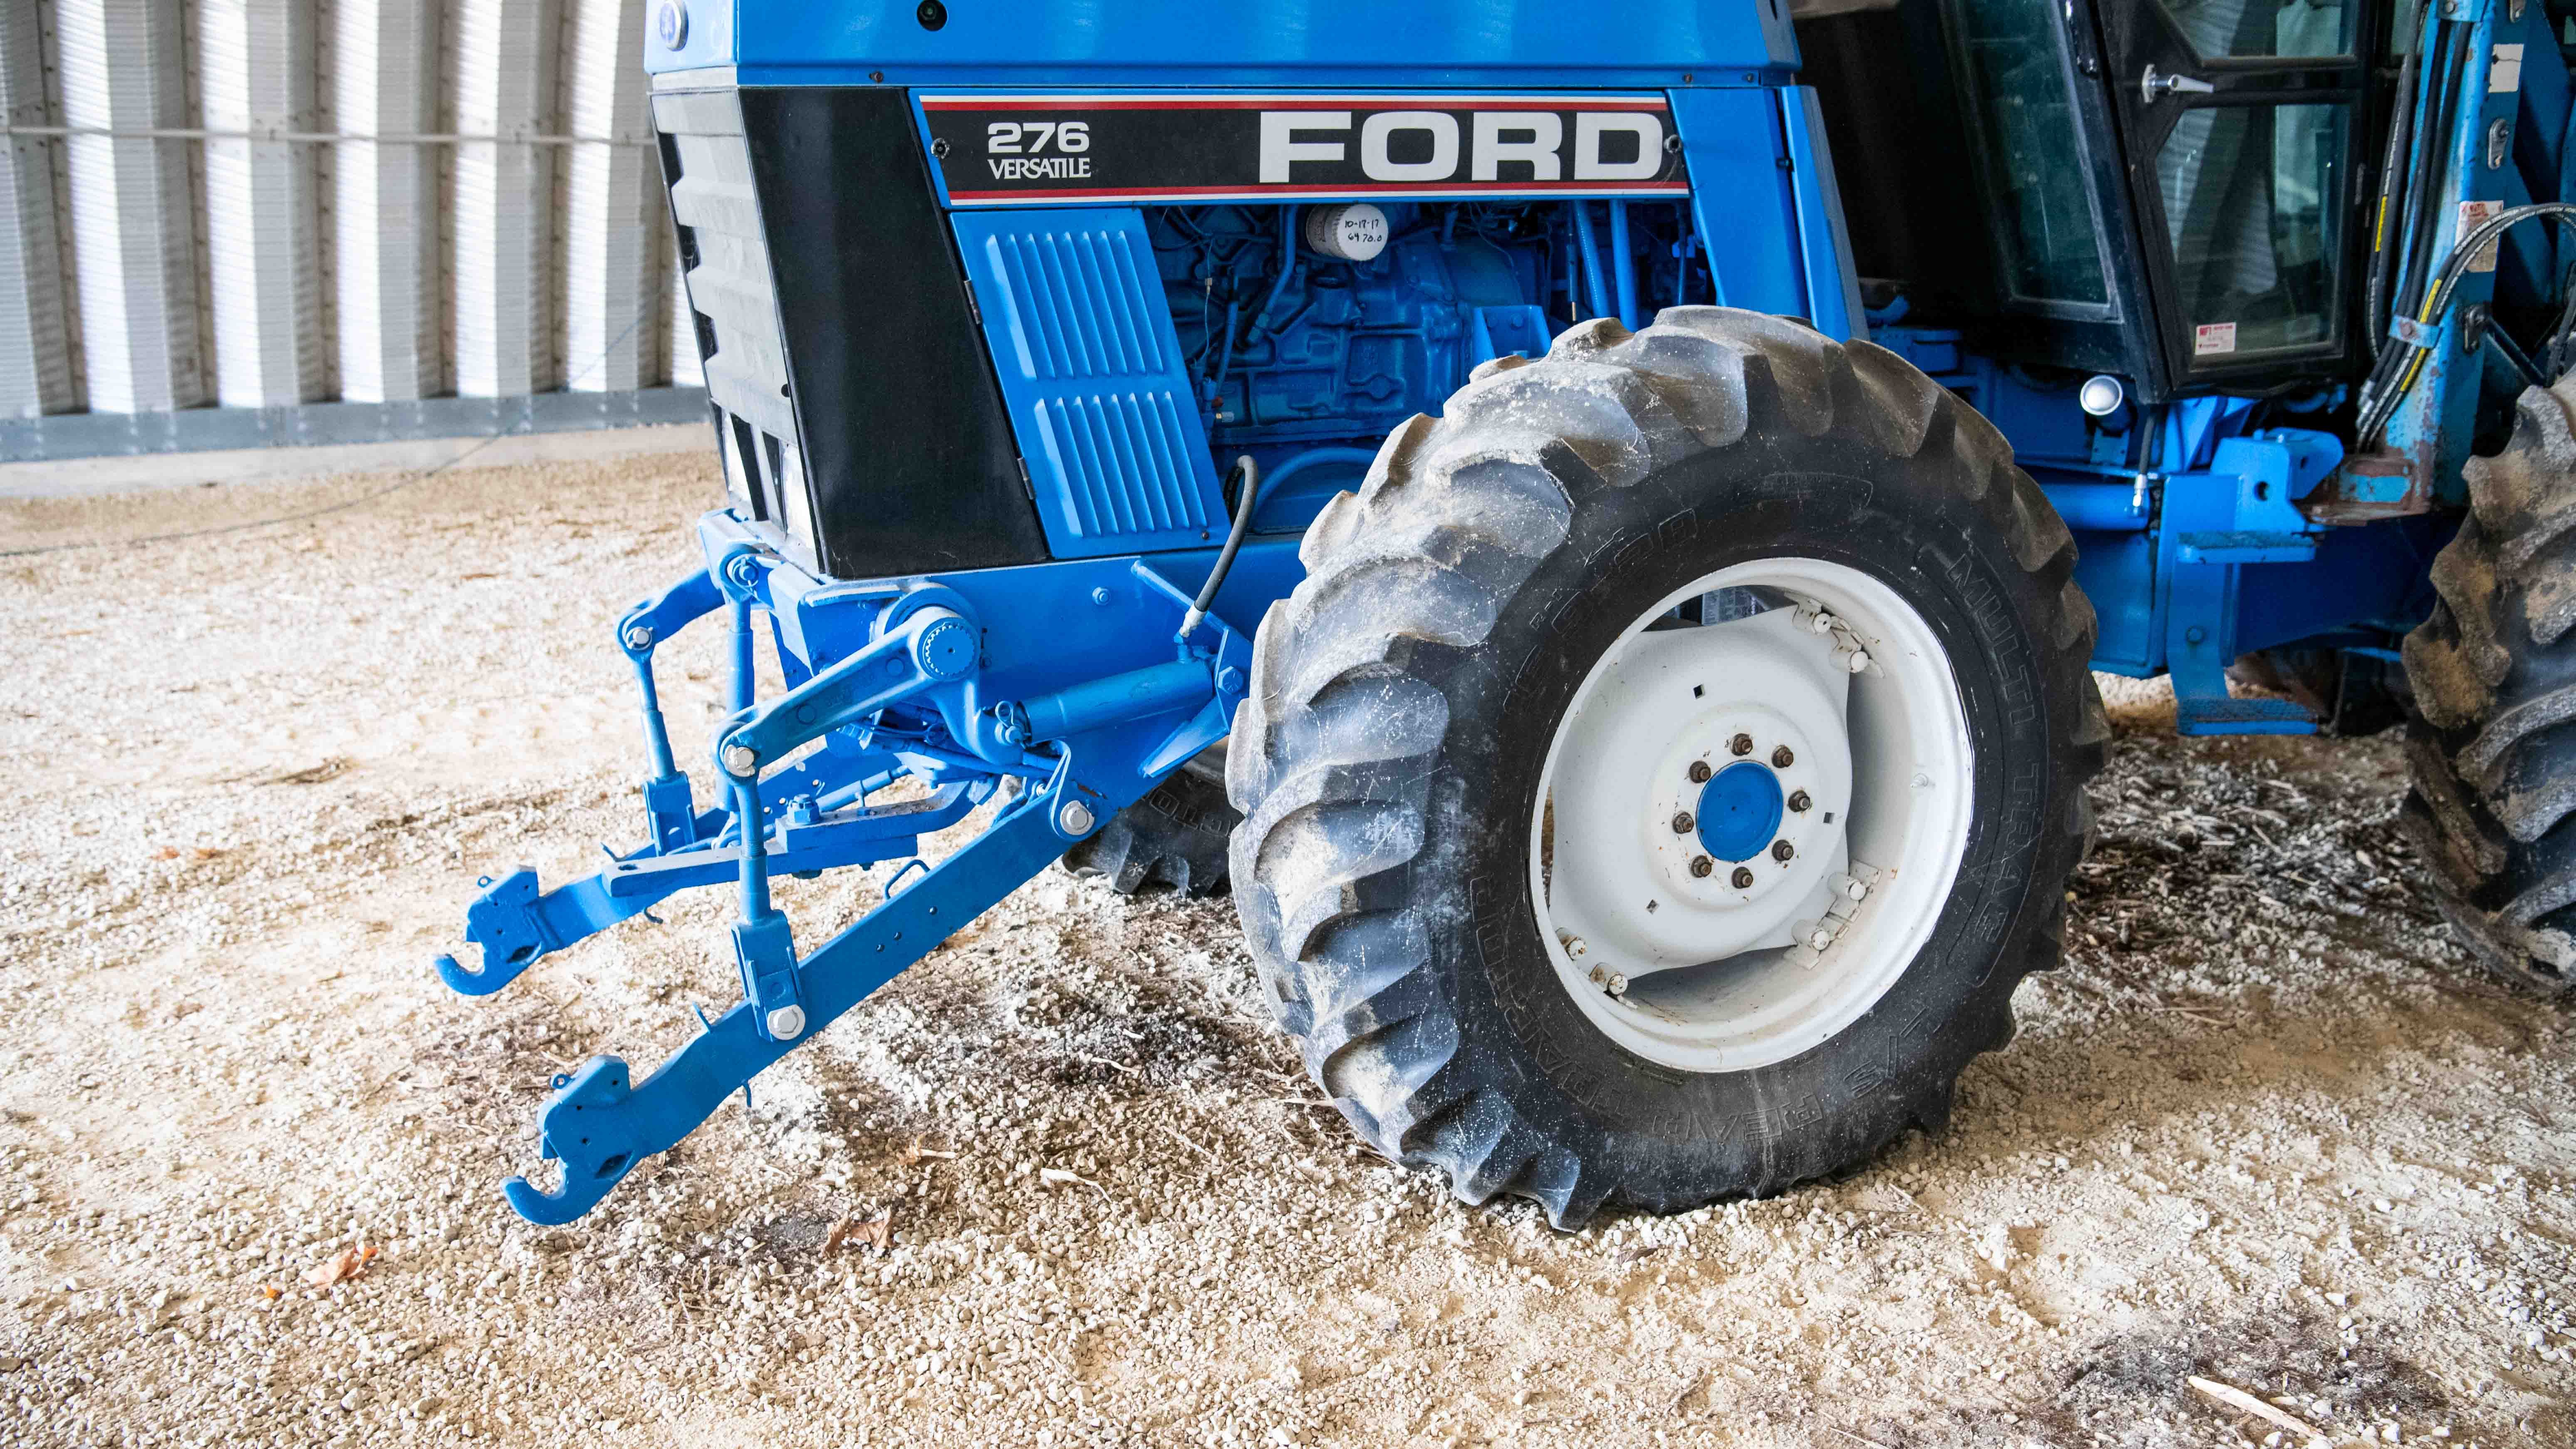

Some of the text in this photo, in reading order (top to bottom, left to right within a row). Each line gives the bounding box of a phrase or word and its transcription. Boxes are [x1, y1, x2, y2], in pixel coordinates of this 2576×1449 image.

[988, 121, 1090, 153] 276
[1259, 111, 1664, 183] FORD
[987, 157, 1092, 180] VERSATILE
[1945, 552, 2036, 726] MULTI
